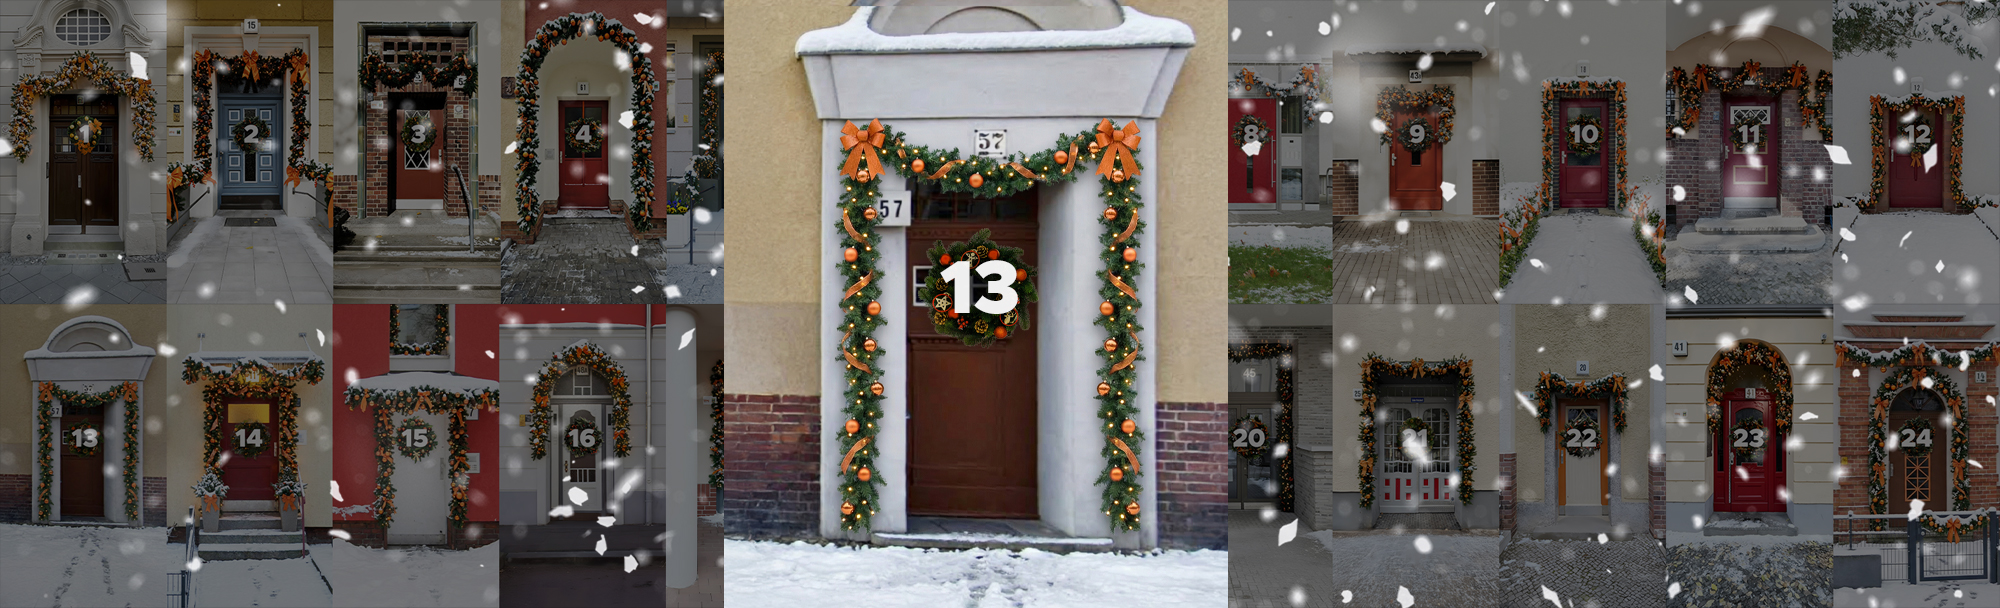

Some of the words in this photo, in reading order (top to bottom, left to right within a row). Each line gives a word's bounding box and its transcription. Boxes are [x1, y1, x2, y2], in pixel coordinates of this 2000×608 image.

[247, 21, 256, 29] 15
[458, 77, 464, 86] 5
[978, 133, 1004, 150] 57
[880, 200, 902, 218] 57
[1674, 342, 1683, 351] 41
[1579, 363, 1587, 372] 20
[1243, 368, 1256, 378] 45
[51, 407, 60, 415] 57
